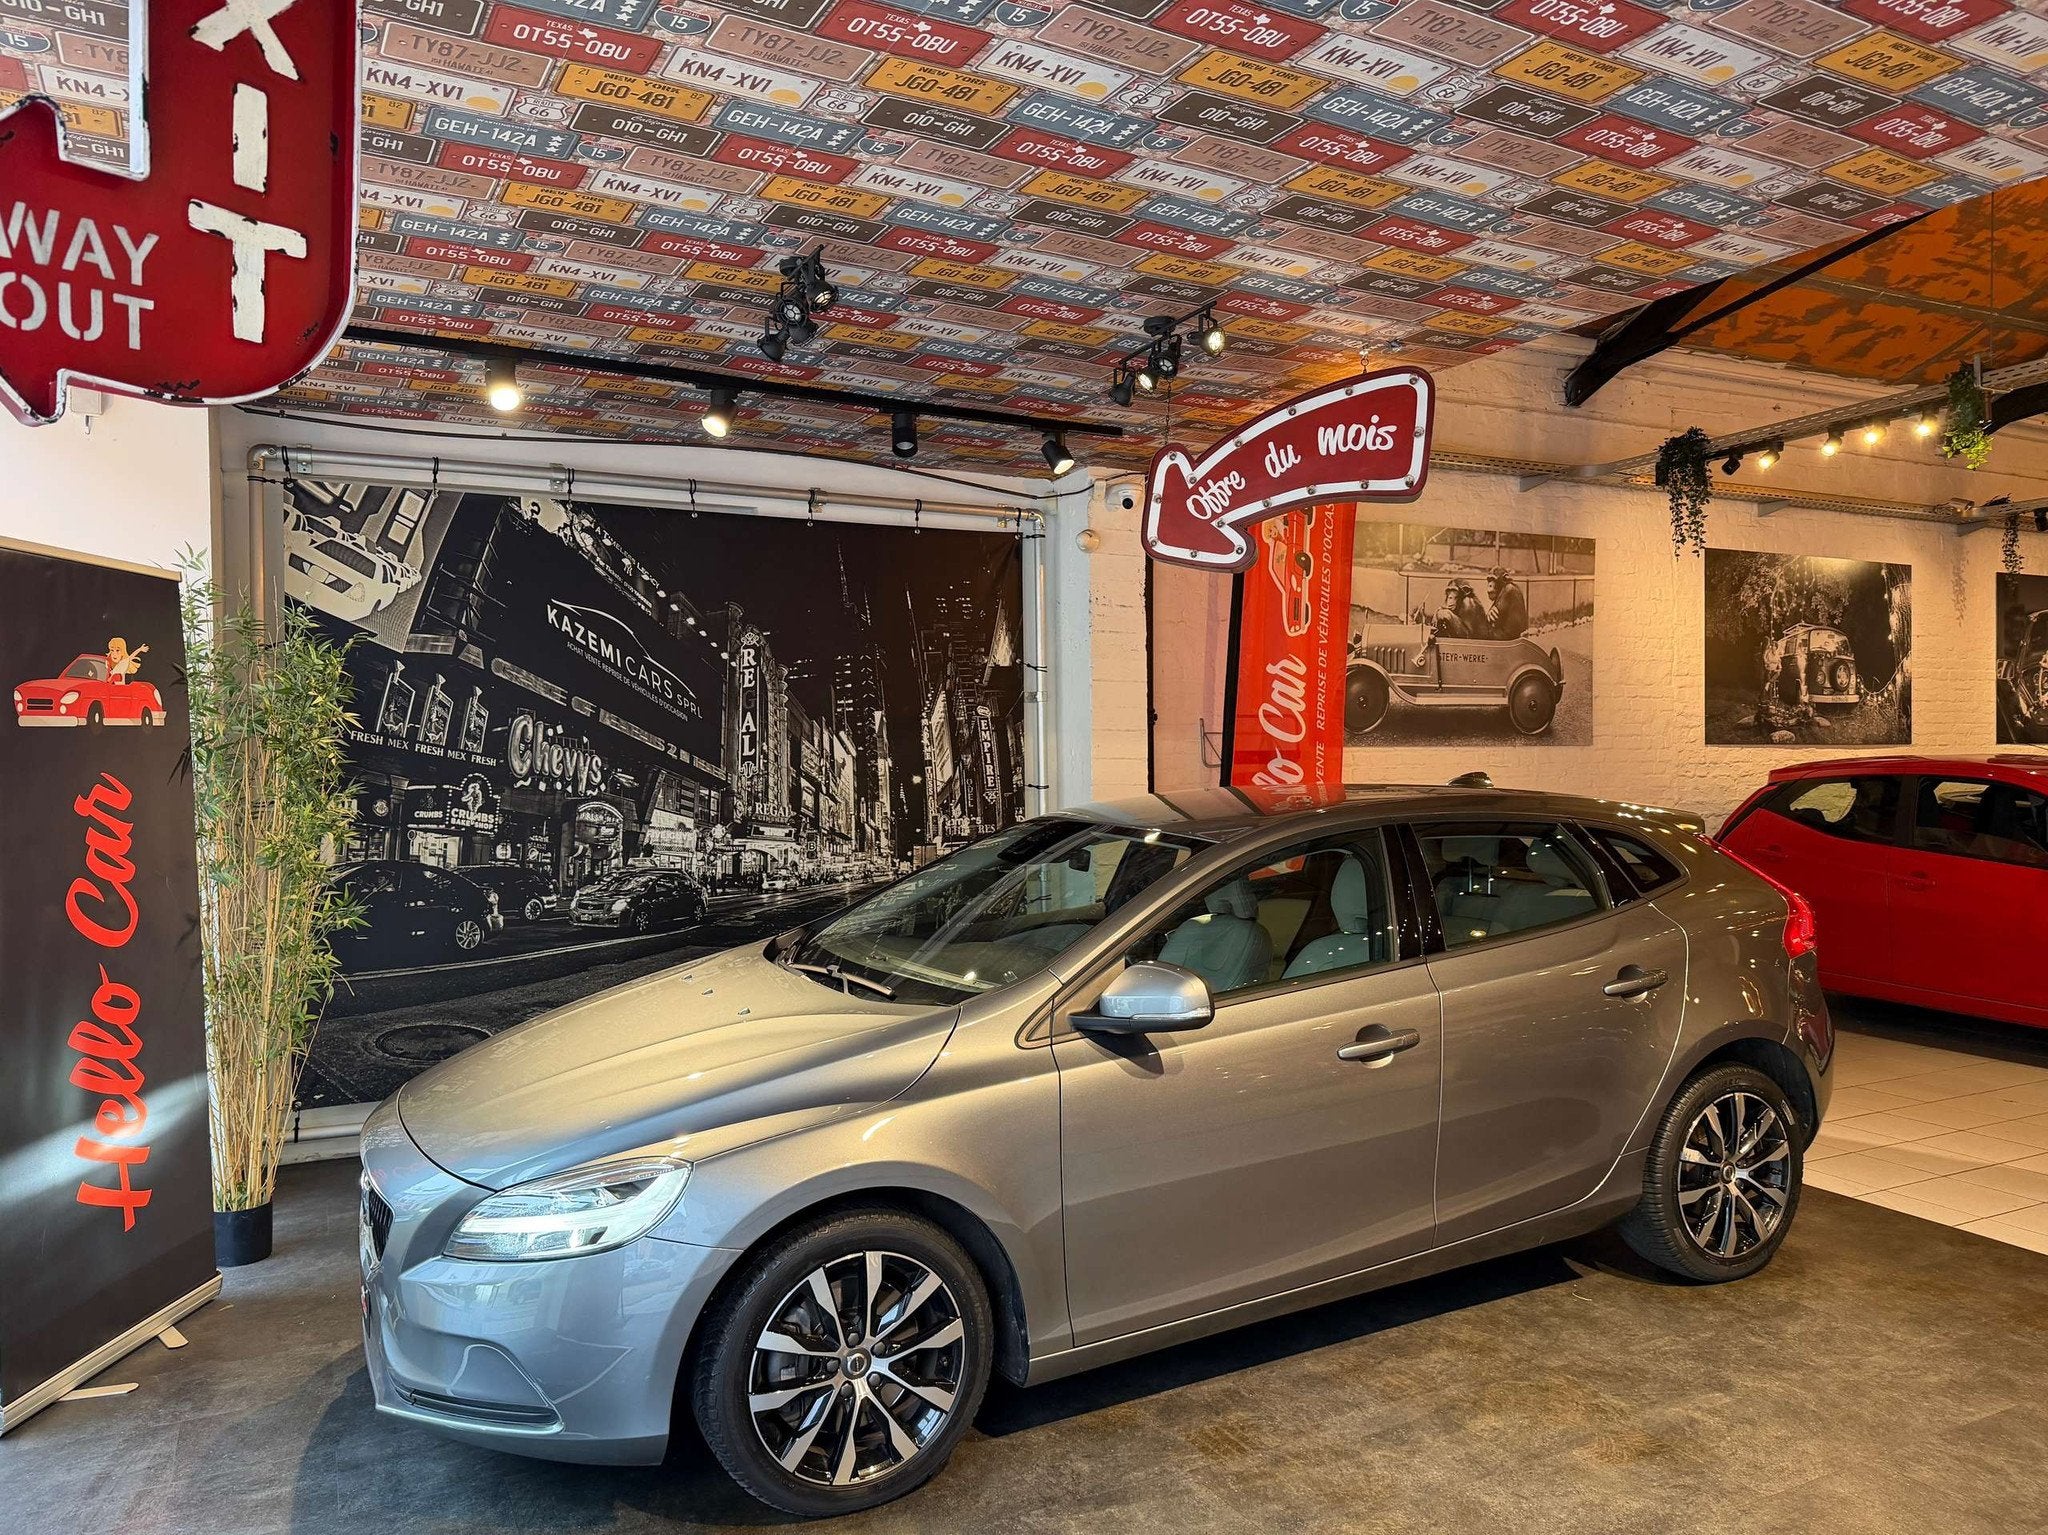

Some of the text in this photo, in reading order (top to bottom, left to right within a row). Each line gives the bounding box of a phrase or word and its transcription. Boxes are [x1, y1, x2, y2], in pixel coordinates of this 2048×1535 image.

[884, 12, 913, 23] TEXAS
[1004, 8, 1031, 23] 15
[1226, 5, 1255, 16] TEXAS
[546, 19, 575, 30] TEXAS
[667, 15, 692, 29] 15
[6, 32, 28, 47] 15
[917, 66, 990, 86] NEW YORK
[1235, 61, 1304, 81] NEW YORK
[604, 73, 681, 92] NEW YORK
[589, 147, 609, 157] 15
[867, 141, 889, 152] 15
[0, 201, 160, 287] WAY
[0, 271, 154, 350] OUT
[1186, 413, 1398, 521] Offre du mois
[1319, 568, 1331, 650] VÉHICULES
[1318, 650, 1328, 671] DE
[676, 693, 703, 719] SPRL
[1258, 652, 1307, 743] Car
[1316, 673, 1327, 730] REPRISE
[350, 730, 497, 767] FRESH MEX FRESH MEX FRESH
[508, 713, 603, 797] Chevys
[980, 719, 996, 788] EMPIRE
[1315, 741, 1324, 785] VENTE
[414, 810, 443, 820] CRUMBS
[451, 808, 495, 824] CRUMBS
[66, 772, 152, 1231] Hello Car
